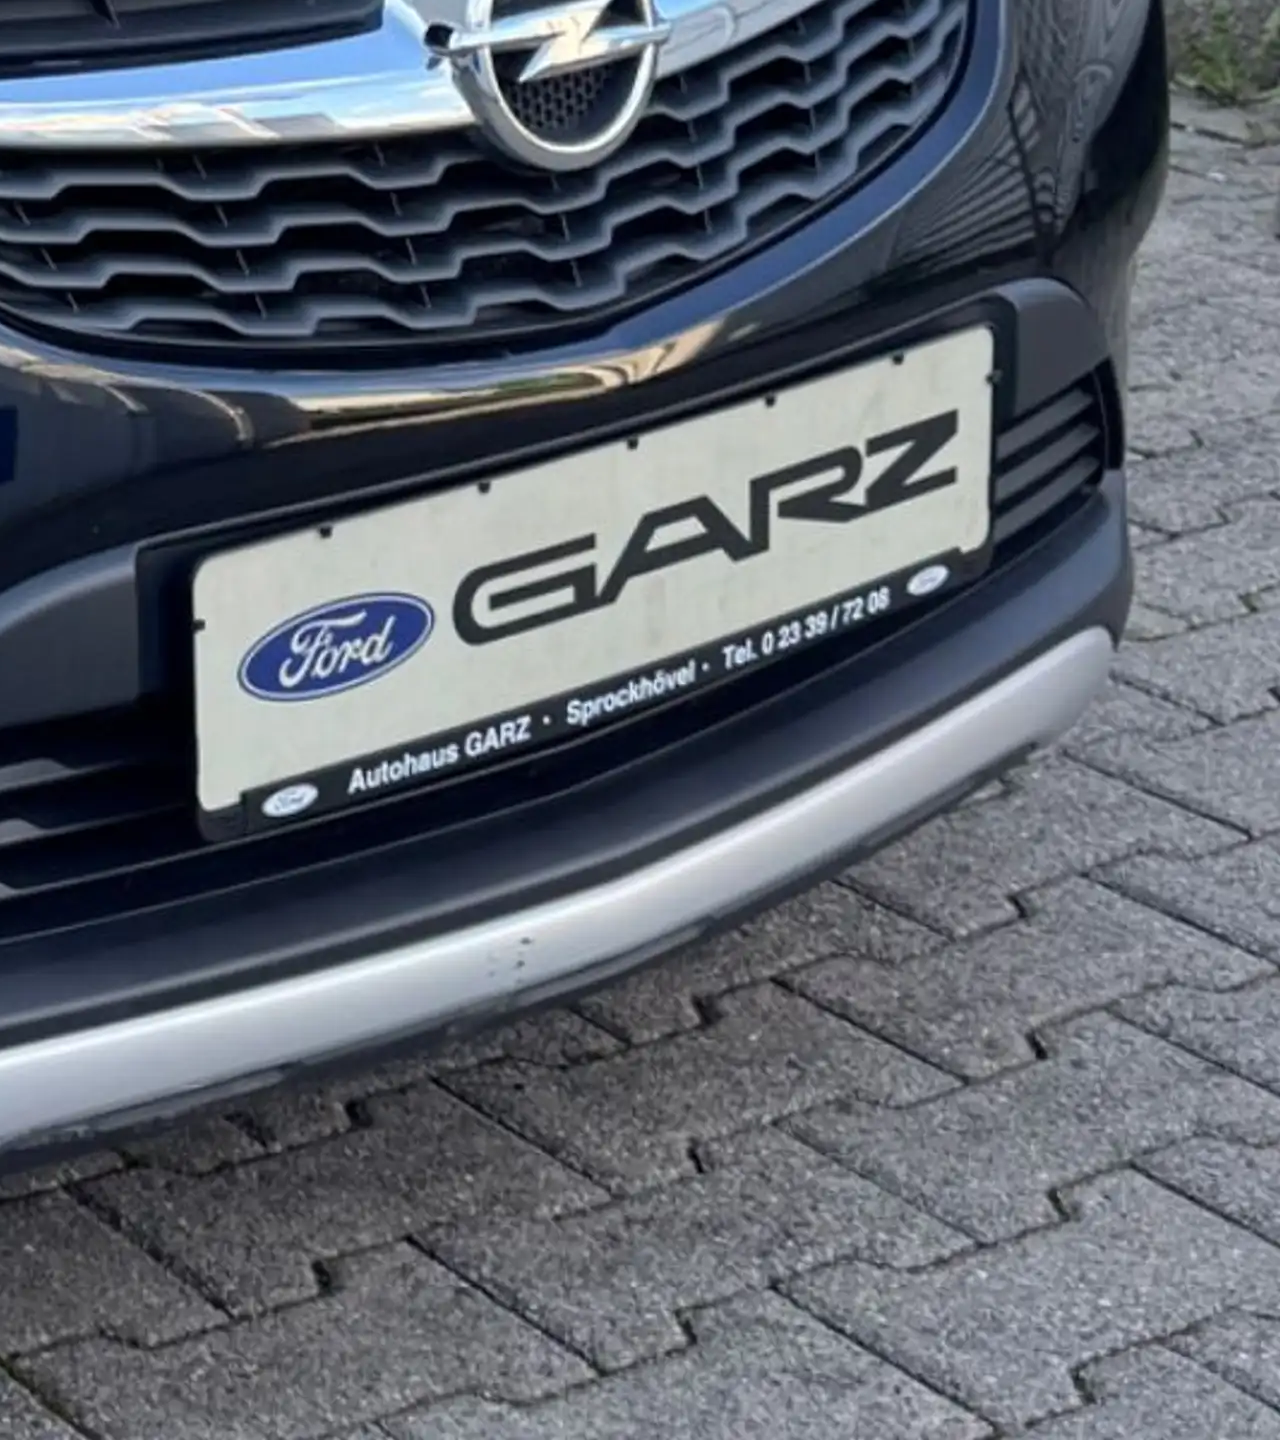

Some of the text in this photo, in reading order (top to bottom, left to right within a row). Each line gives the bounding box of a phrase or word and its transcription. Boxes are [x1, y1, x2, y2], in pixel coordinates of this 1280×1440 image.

[452, 408, 959, 646] GARZ
[278, 603, 392, 688] Ford
[347, 743, 459, 794] Autohaus
[464, 715, 532, 758] GARZ
[566, 658, 697, 727] Sprockhövel
[722, 638, 757, 670] Tel.
